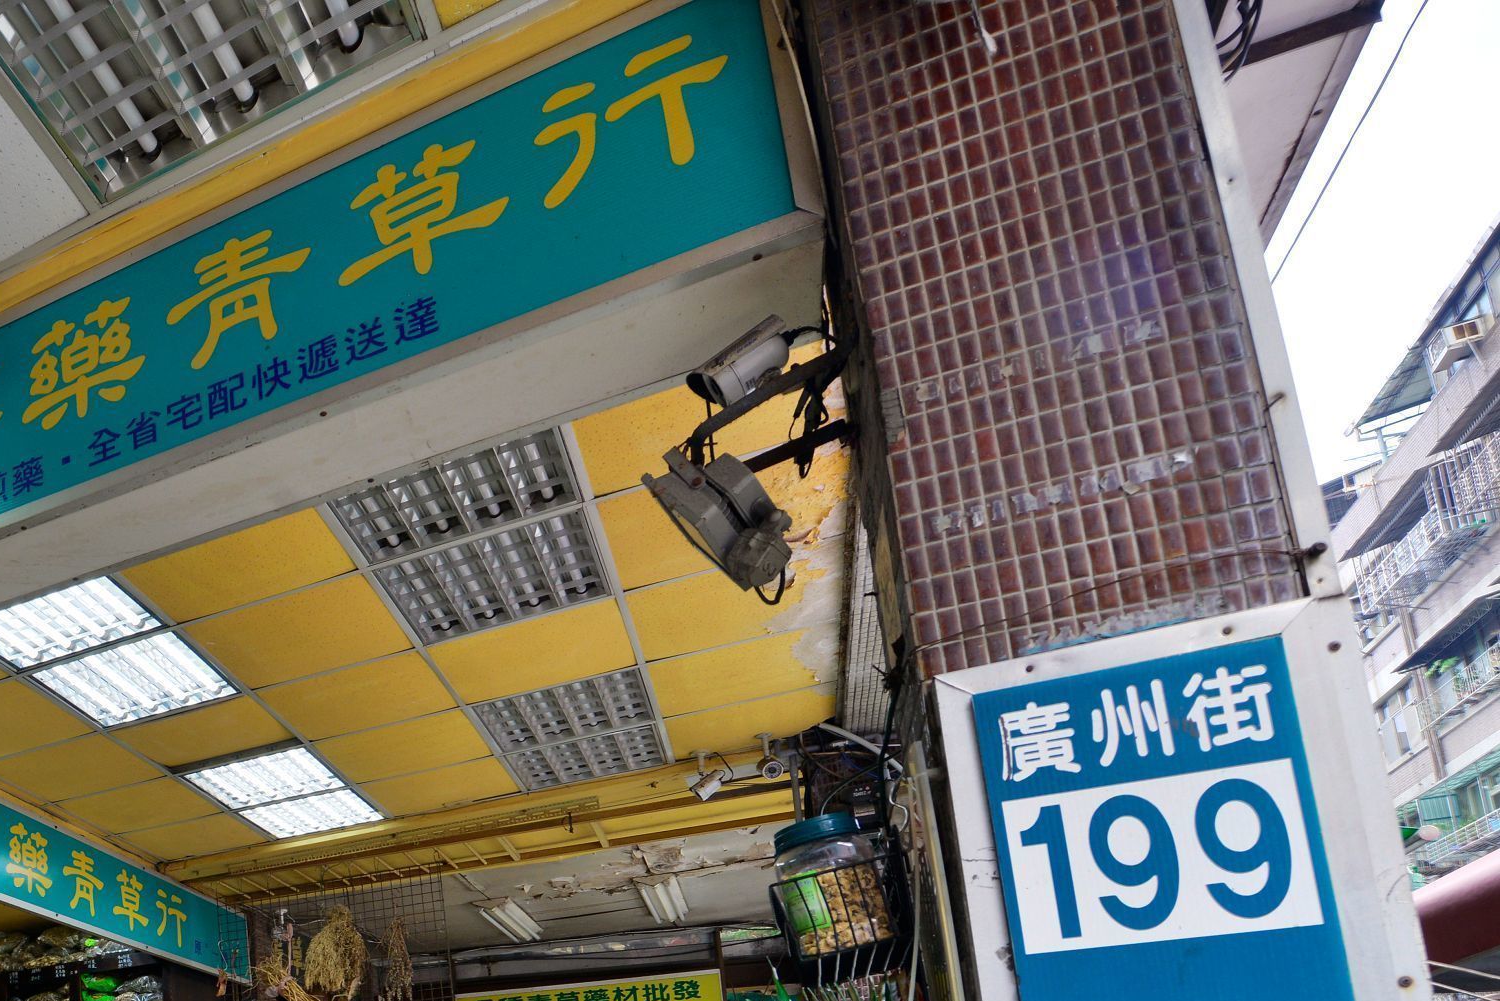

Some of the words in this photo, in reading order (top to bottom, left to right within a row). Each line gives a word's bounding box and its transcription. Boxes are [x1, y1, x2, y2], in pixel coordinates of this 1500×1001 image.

[999, 663, 1275, 783] 廣州街
[1019, 777, 1293, 939] 199
